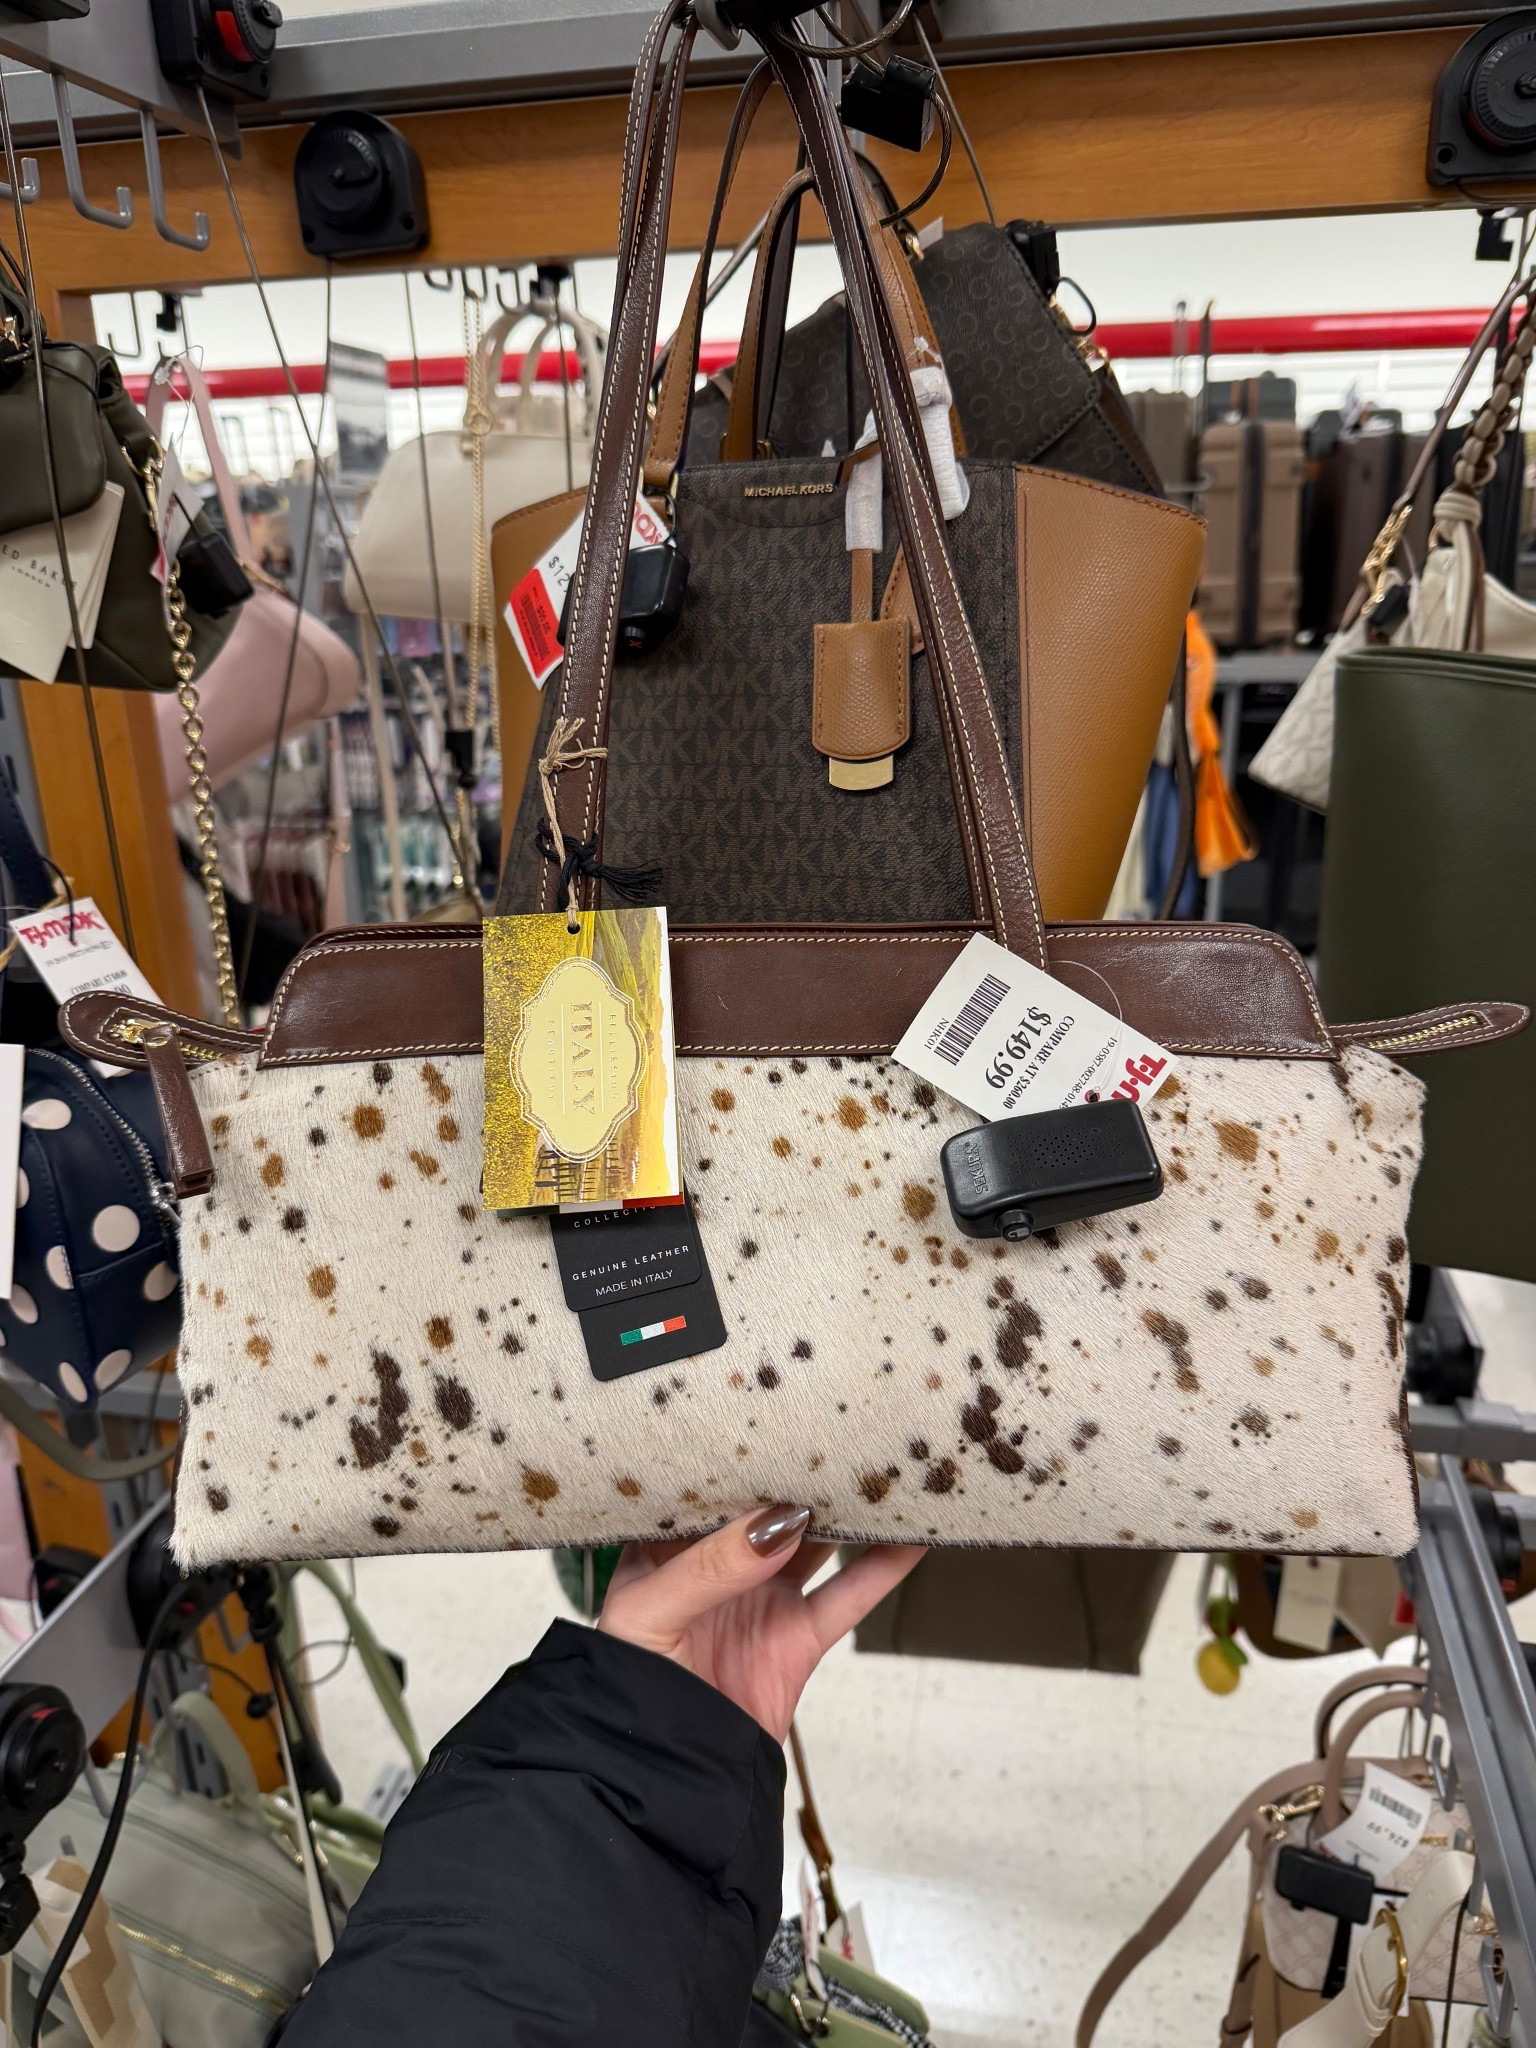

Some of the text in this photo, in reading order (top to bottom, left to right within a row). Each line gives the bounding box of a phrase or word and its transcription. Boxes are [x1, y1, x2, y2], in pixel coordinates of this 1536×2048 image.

[744, 483, 834, 497] MICHAEL KORS
[1, 544, 20, 560] ED
[924, 1017, 949, 1050] NHK01
[985, 1006, 1052, 1089] $149.99
[571, 1001, 595, 1115] ITALY
[1002, 1015, 1075, 1110] COMPARE AT $260.00
[572, 1245, 689, 1281] GENUINE LEATHER
[595, 1269, 674, 1297] MADE IN ITALY
